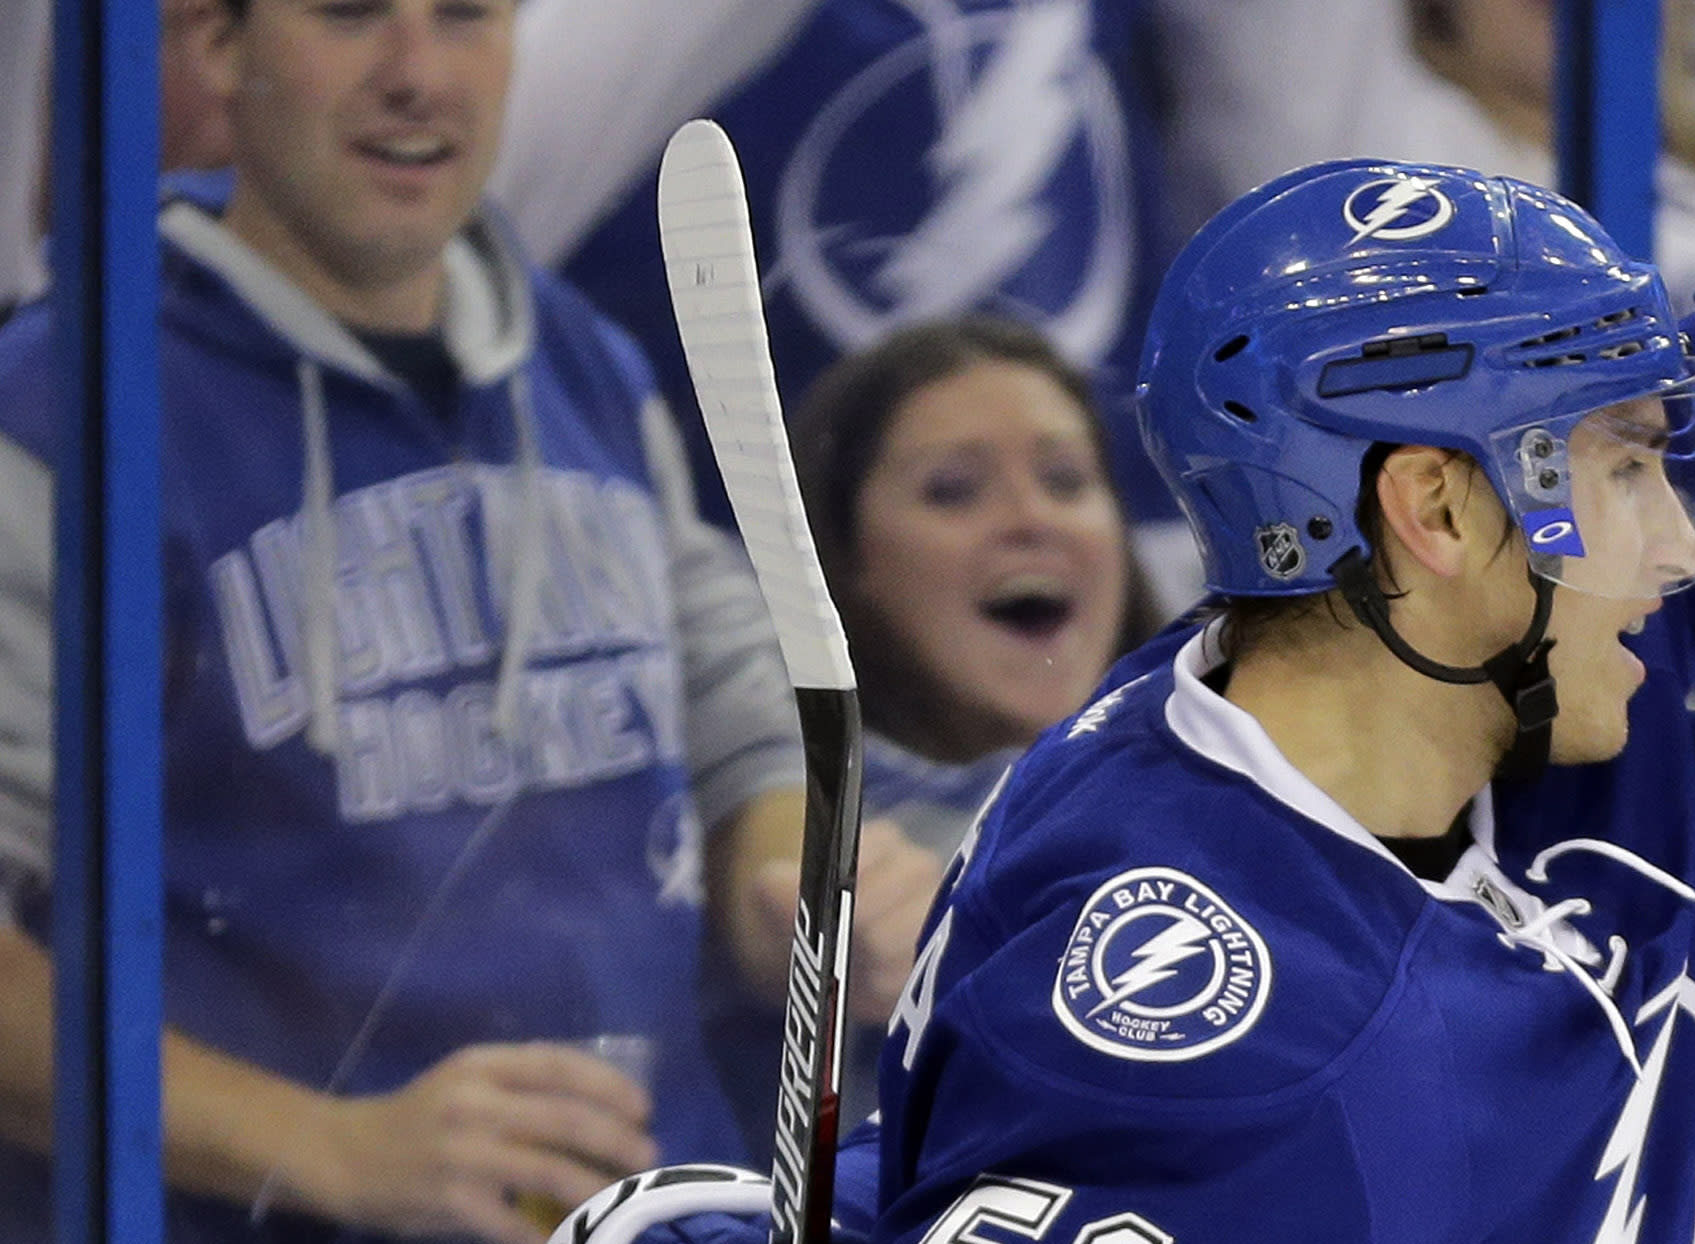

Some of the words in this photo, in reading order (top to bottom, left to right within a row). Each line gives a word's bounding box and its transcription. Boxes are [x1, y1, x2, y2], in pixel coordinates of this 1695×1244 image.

[1065, 911, 1112, 1000] TAMPA
[1112, 880, 1176, 909] BAY
[1184, 892, 1256, 1027] LIGHTNING
[1111, 1010, 1172, 1033] HOCKEY
[1118, 1025, 1157, 1042] CLUB
